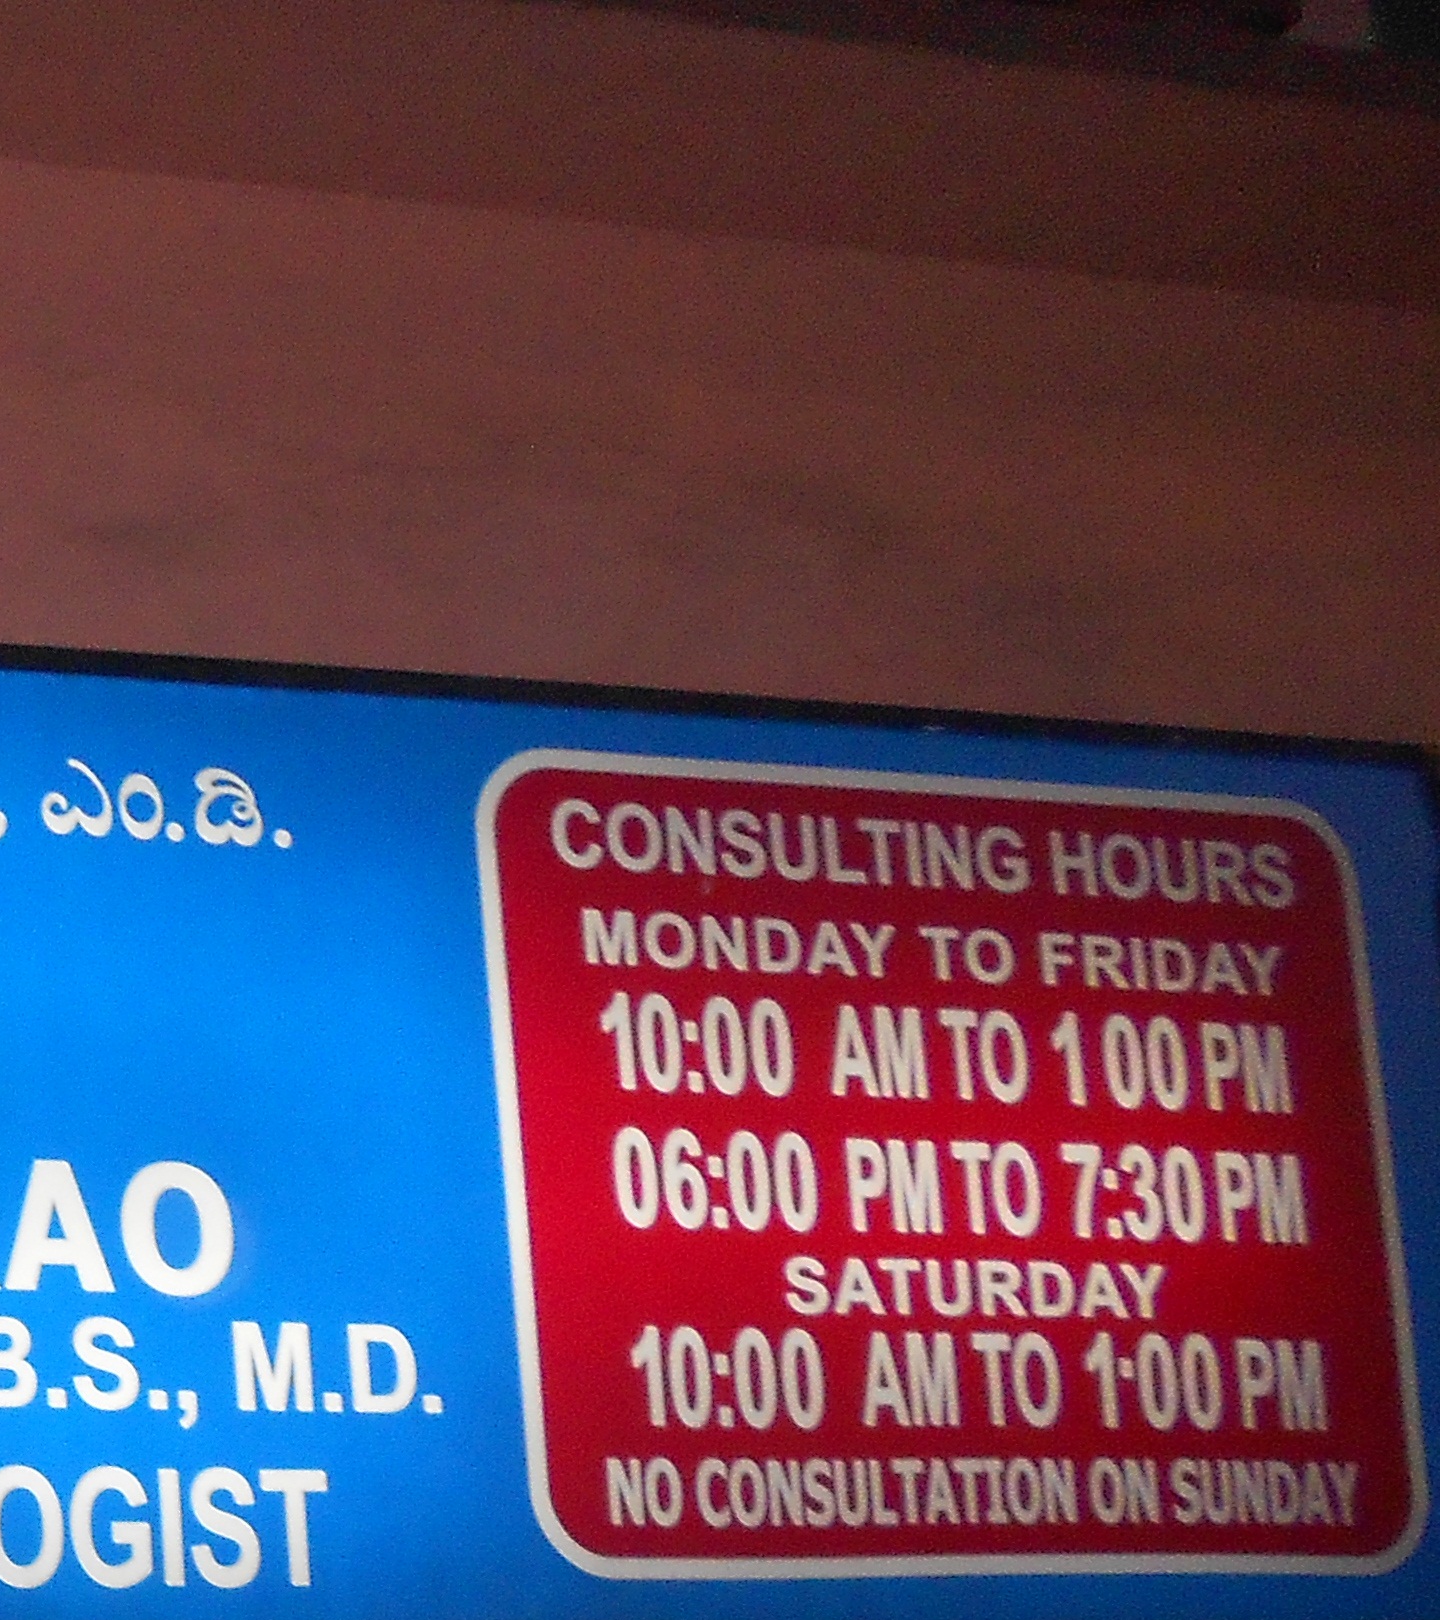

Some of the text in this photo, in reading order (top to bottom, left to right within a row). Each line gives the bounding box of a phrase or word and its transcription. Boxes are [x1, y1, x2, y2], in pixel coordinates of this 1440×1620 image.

[39, 756, 295, 851] ಎಂ.ಡಿ.
[550, 797, 1298, 910] CONSULTING HOURS
[580, 906, 1284, 998] MONDAY TO FRIDAY
[598, 989, 795, 1099] 10:00
[829, 1002, 931, 1102] AM
[936, 1007, 1030, 1106] TO
[1198, 1020, 1296, 1115] PM
[610, 1123, 1310, 1246] 06:00 PM TO 7:30 PM
[782, 1253, 1167, 1321] SATURDAY
[229, 1318, 445, 1417] M.D.
[628, 1322, 827, 1432] 10:00
[861, 1329, 961, 1429] AM
[968, 1329, 1063, 1430] TO
[1233, 1335, 1332, 1432] PM
[604, 1454, 1360, 1530] NO CONSULTATION ON SUNDAY
